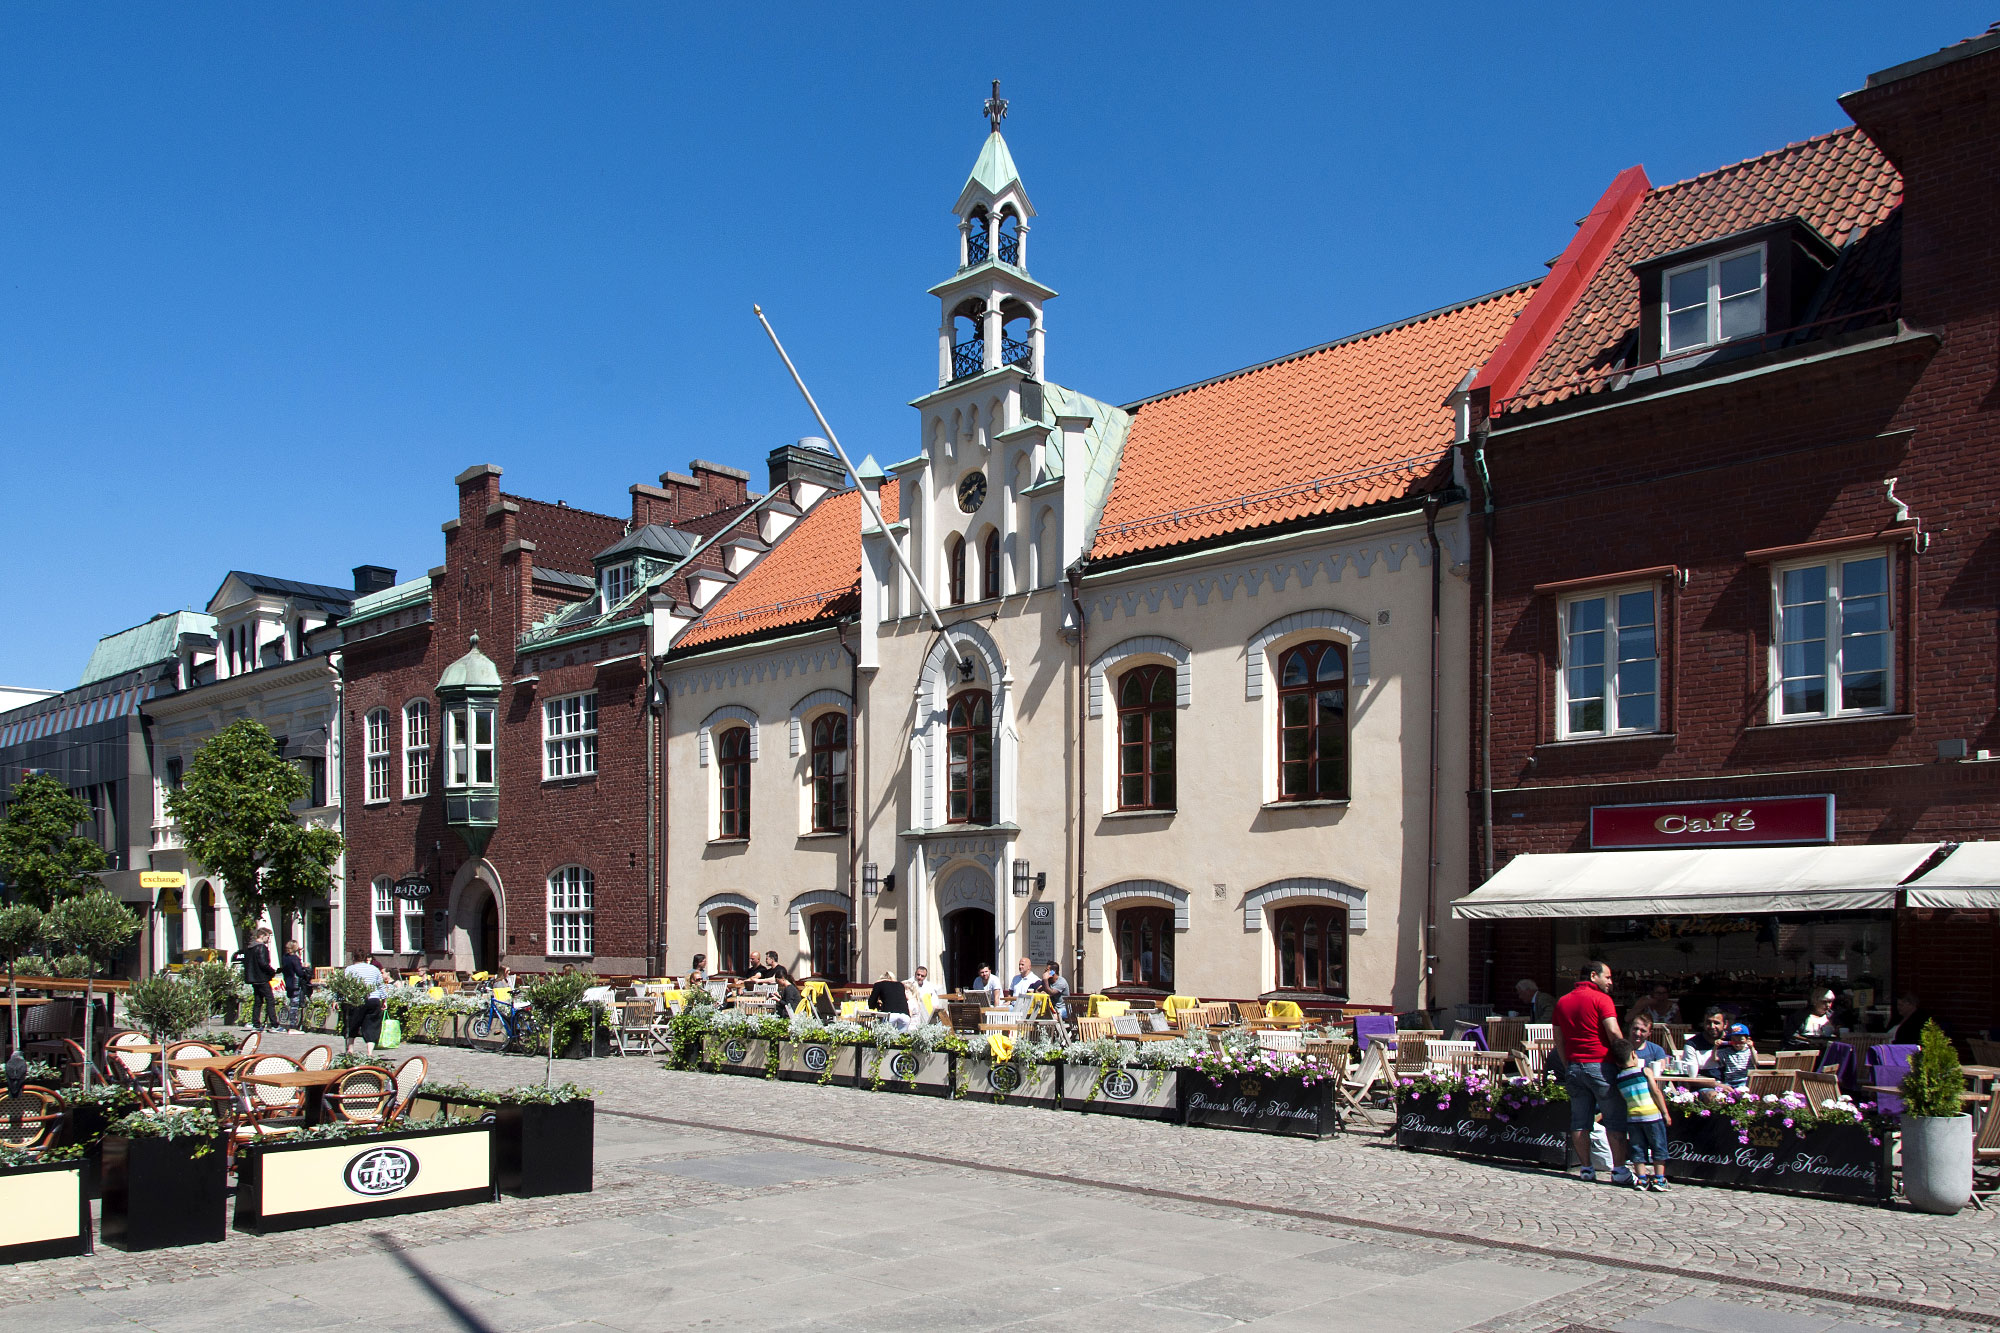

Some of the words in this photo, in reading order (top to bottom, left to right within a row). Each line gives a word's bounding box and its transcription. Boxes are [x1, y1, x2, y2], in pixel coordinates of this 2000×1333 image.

[1654, 808, 1755, 834] Café
[394, 884, 431, 897] BAREN
[1190, 1092, 1231, 1112] Princess
[1232, 1097, 1257, 1117] Café
[1267, 1100, 1319, 1120] Konditori
[1401, 1113, 1455, 1134] Princess
[1456, 1119, 1488, 1142] Café
[1501, 1124, 1567, 1148] Konditori
[1668, 1140, 1732, 1165] Princess
[1734, 1147, 1775, 1173] Café
[1791, 1152, 1878, 1180] Konditori
